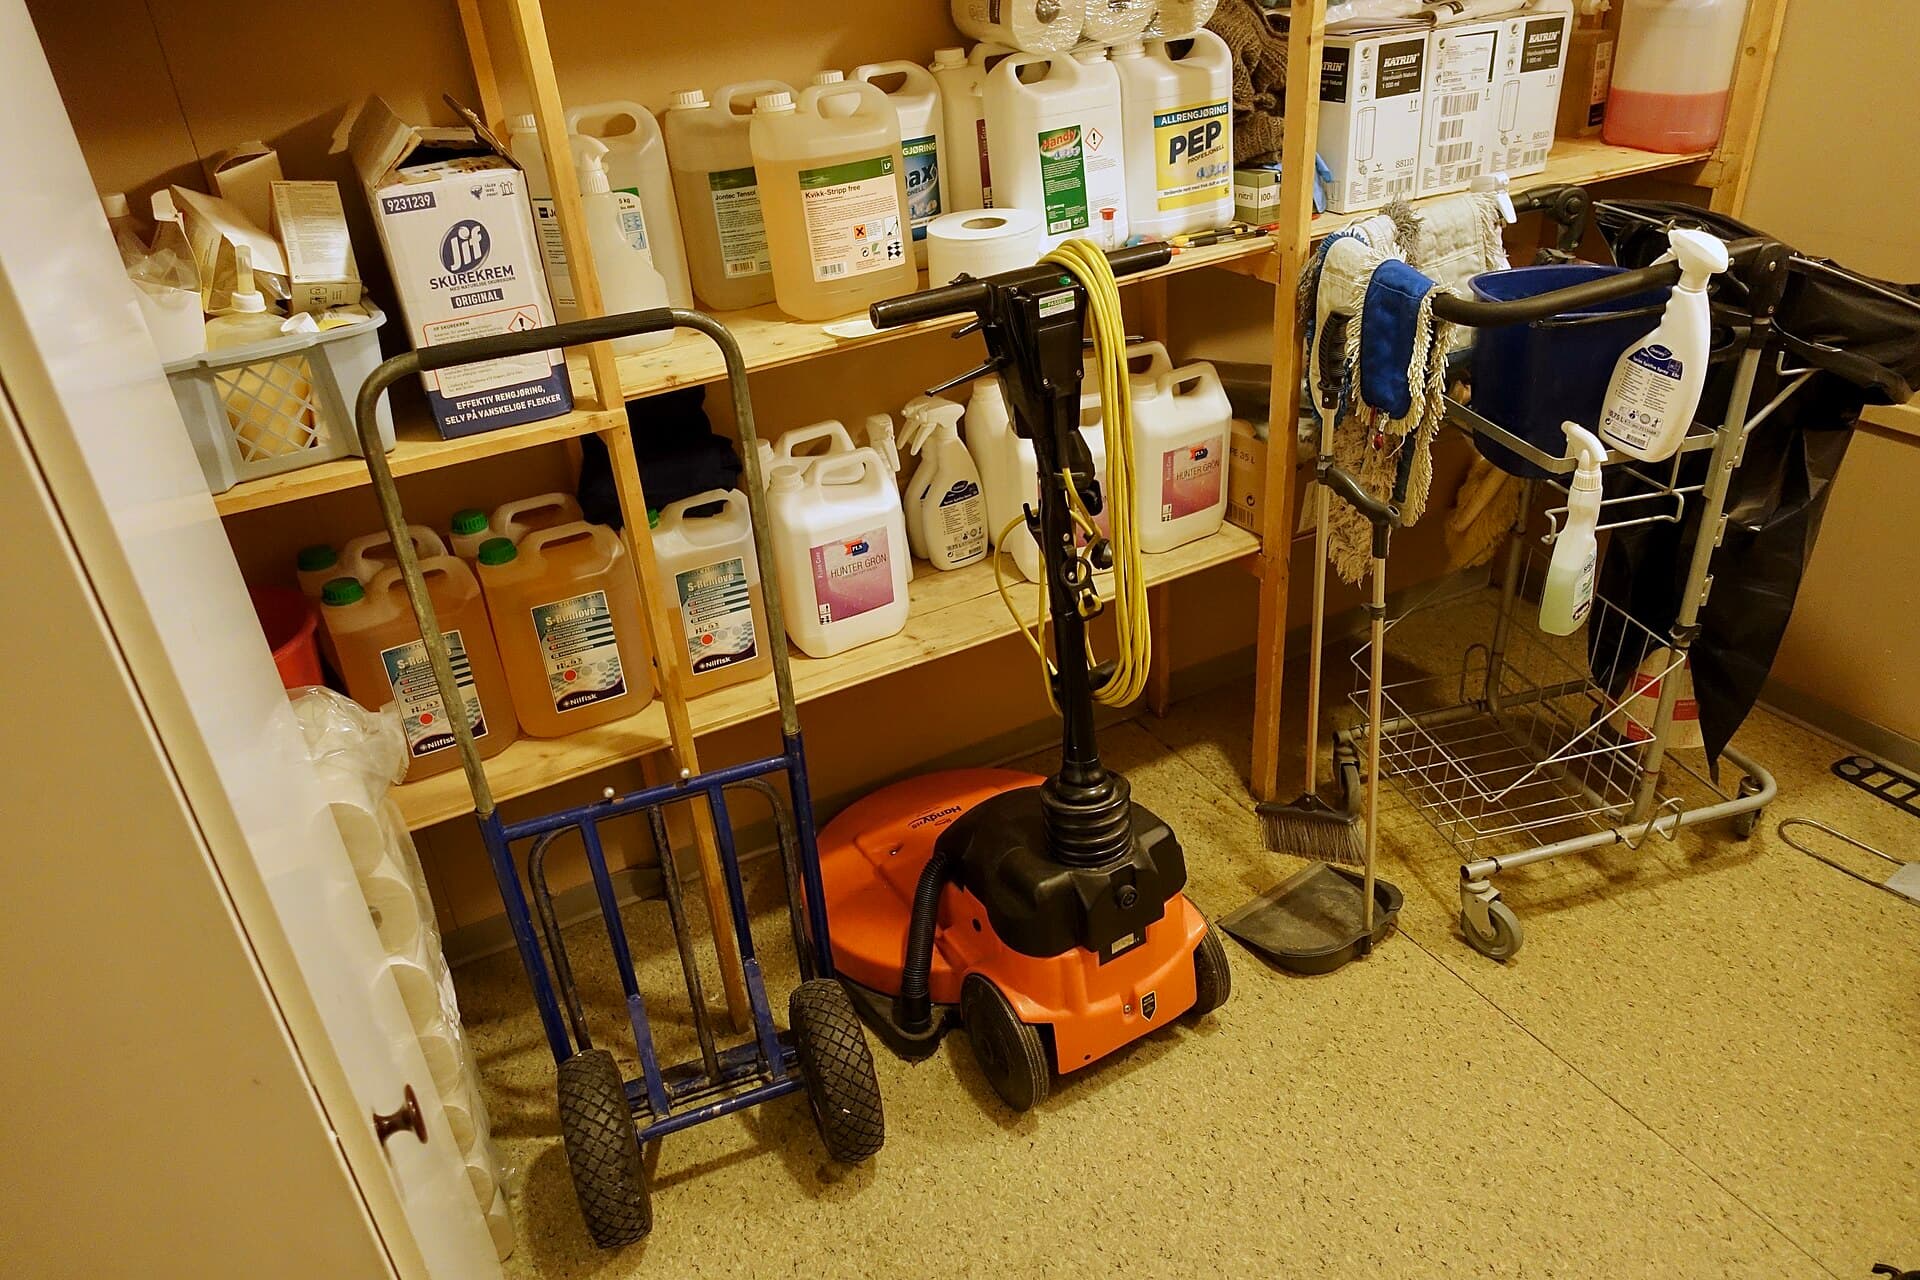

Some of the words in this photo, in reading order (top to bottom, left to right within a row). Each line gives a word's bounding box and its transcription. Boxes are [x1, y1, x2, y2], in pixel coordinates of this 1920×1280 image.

[1528, 31, 1559, 44] KATRIN
[1384, 54, 1418, 68] KATRIN
[1160, 104, 1228, 126] ALLRENGJØRING
[1042, 128, 1077, 150] Handy
[1169, 120, 1222, 165] PEP
[1395, 157, 1414, 169] 88110
[805, 187, 847, 200] Kvikk-Stripp
[848, 184, 861, 193] free
[1238, 192, 1254, 201] nitril
[387, 194, 432, 213] 9231239
[429, 265, 515, 290] SKUREKREM
[455, 290, 500, 307] ORIGINAL
[455, 395, 495, 411] EFFEKTIV
[495, 384, 546, 403] RENGJØRING,
[445, 413, 466, 426] SELV
[466, 409, 479, 421] PÅ
[479, 401, 528, 419] VANSKELIGE
[527, 393, 562, 409] FLEKKER
[1176, 465, 1202, 481] HUNTER
[830, 561, 863, 578] HUNTER
[687, 573, 736, 592] S-Remove
[544, 606, 597, 627] S-Remove
[705, 656, 732, 669] Nilfisk
[569, 693, 598, 707] Nilfisk
[426, 735, 456, 750] Nilfisk
[922, 805, 962, 824] Handy
